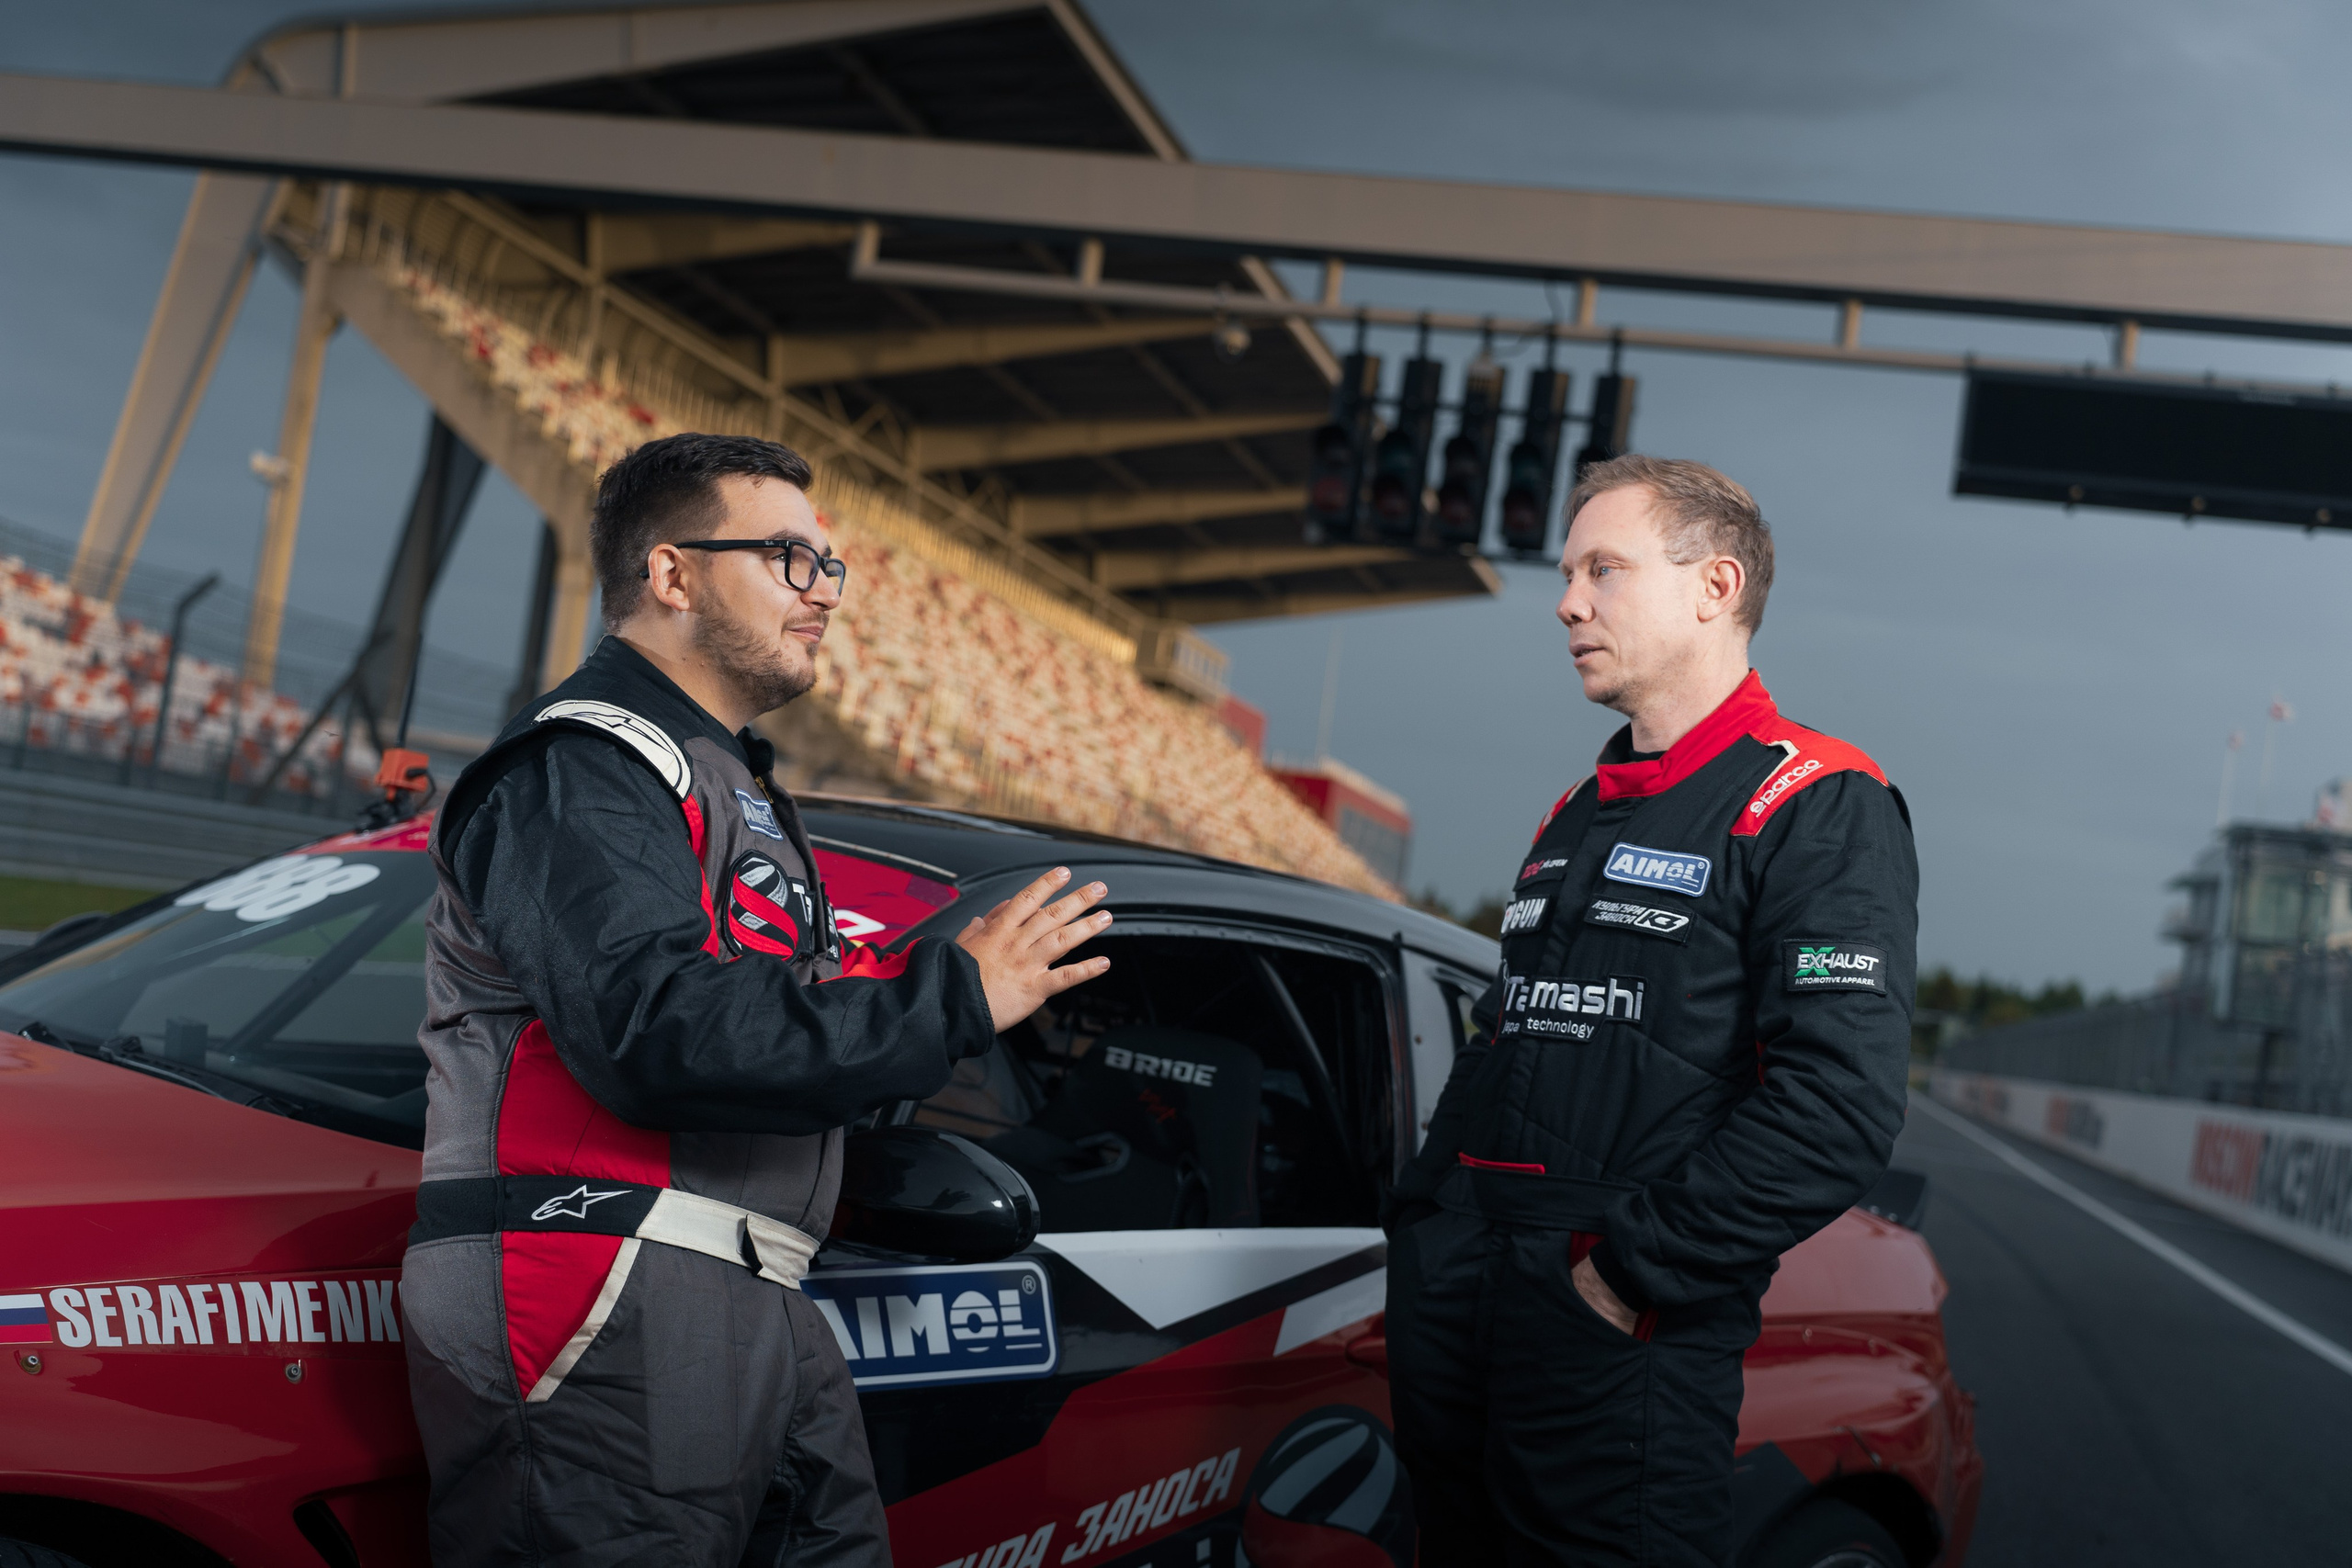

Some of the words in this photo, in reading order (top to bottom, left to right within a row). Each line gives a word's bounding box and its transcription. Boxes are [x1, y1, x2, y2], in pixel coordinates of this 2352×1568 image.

[1749, 760, 1824, 818] sparco
[1611, 853, 1700, 886] AIMOL
[1795, 950, 1879, 975] EXHAUST
[1794, 976, 1840, 986] AUTOMOTIVE
[1841, 976, 1875, 987] APPAREL
[1527, 1017, 1594, 1039] technology
[49, 1280, 403, 1348] SERAFIMENK
[1060, 1447, 1241, 1565] ЗАНОСА
